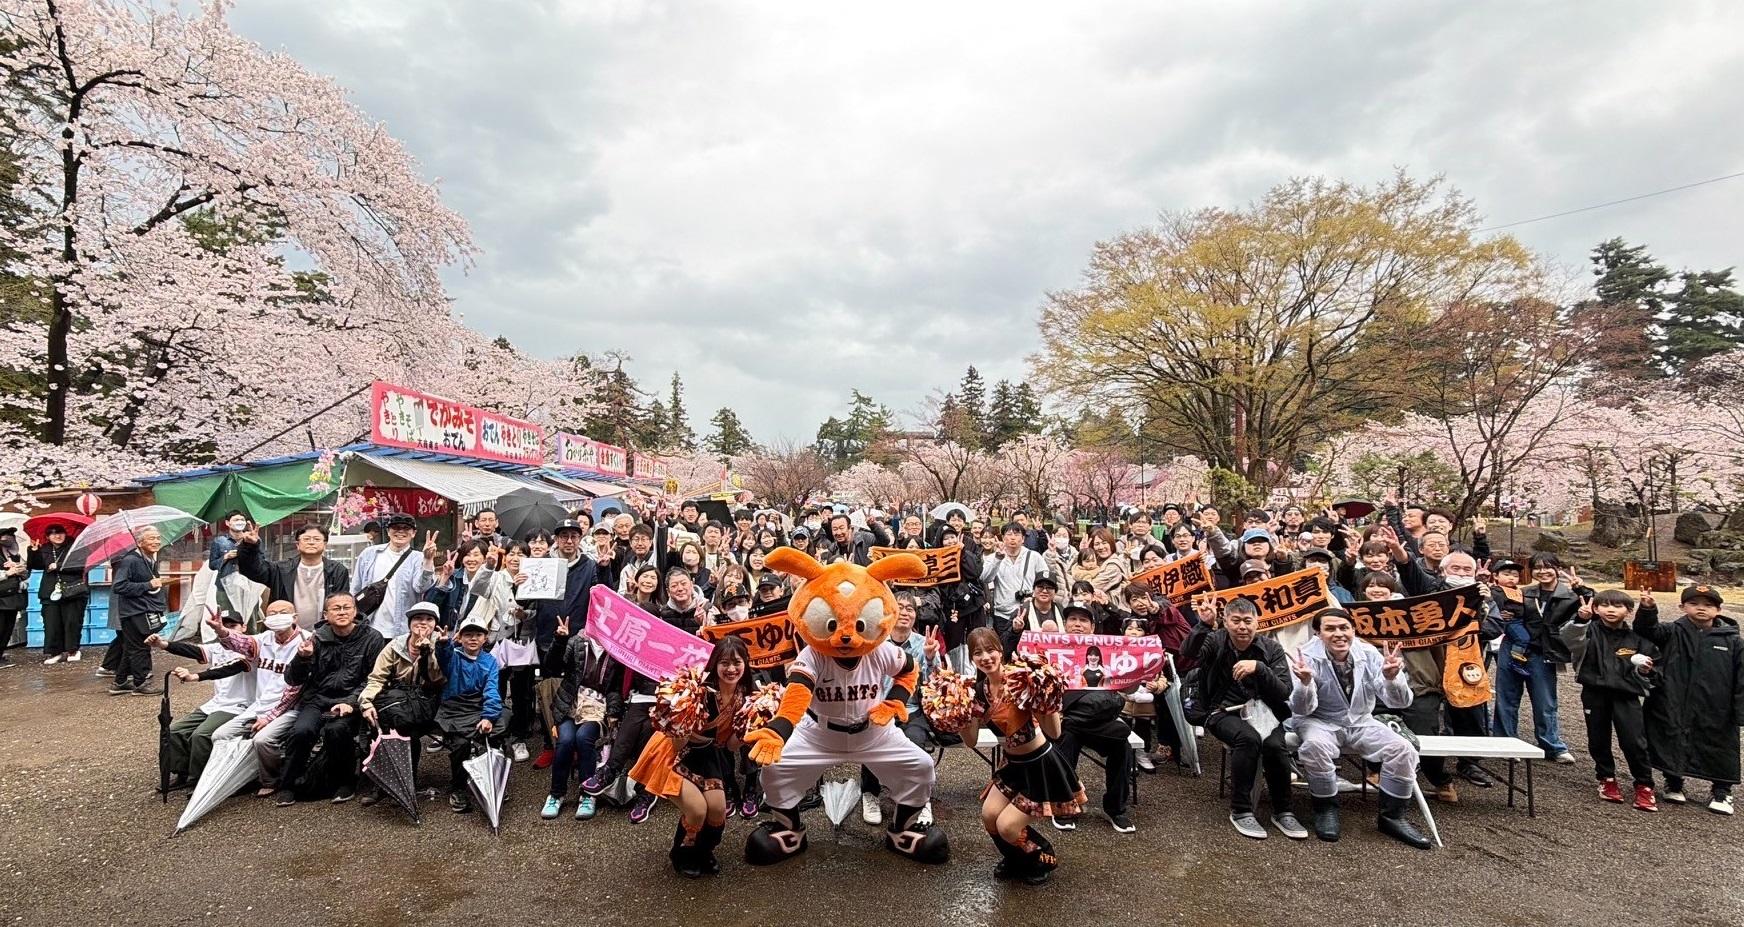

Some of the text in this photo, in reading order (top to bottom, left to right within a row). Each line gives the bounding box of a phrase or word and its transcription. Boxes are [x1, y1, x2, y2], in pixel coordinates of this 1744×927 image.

[427, 399, 474, 435] でかみそ
[443, 429, 466, 452] おでん
[483, 419, 499, 445] おでん
[564, 519, 572, 527] C
[1147, 559, 1205, 596] 崎伊織
[1271, 613, 1298, 626] GIANTS
[1074, 635, 1124, 647] VENUS
[757, 655, 781, 665] GIANTS
[815, 684, 879, 702] GIANTS
